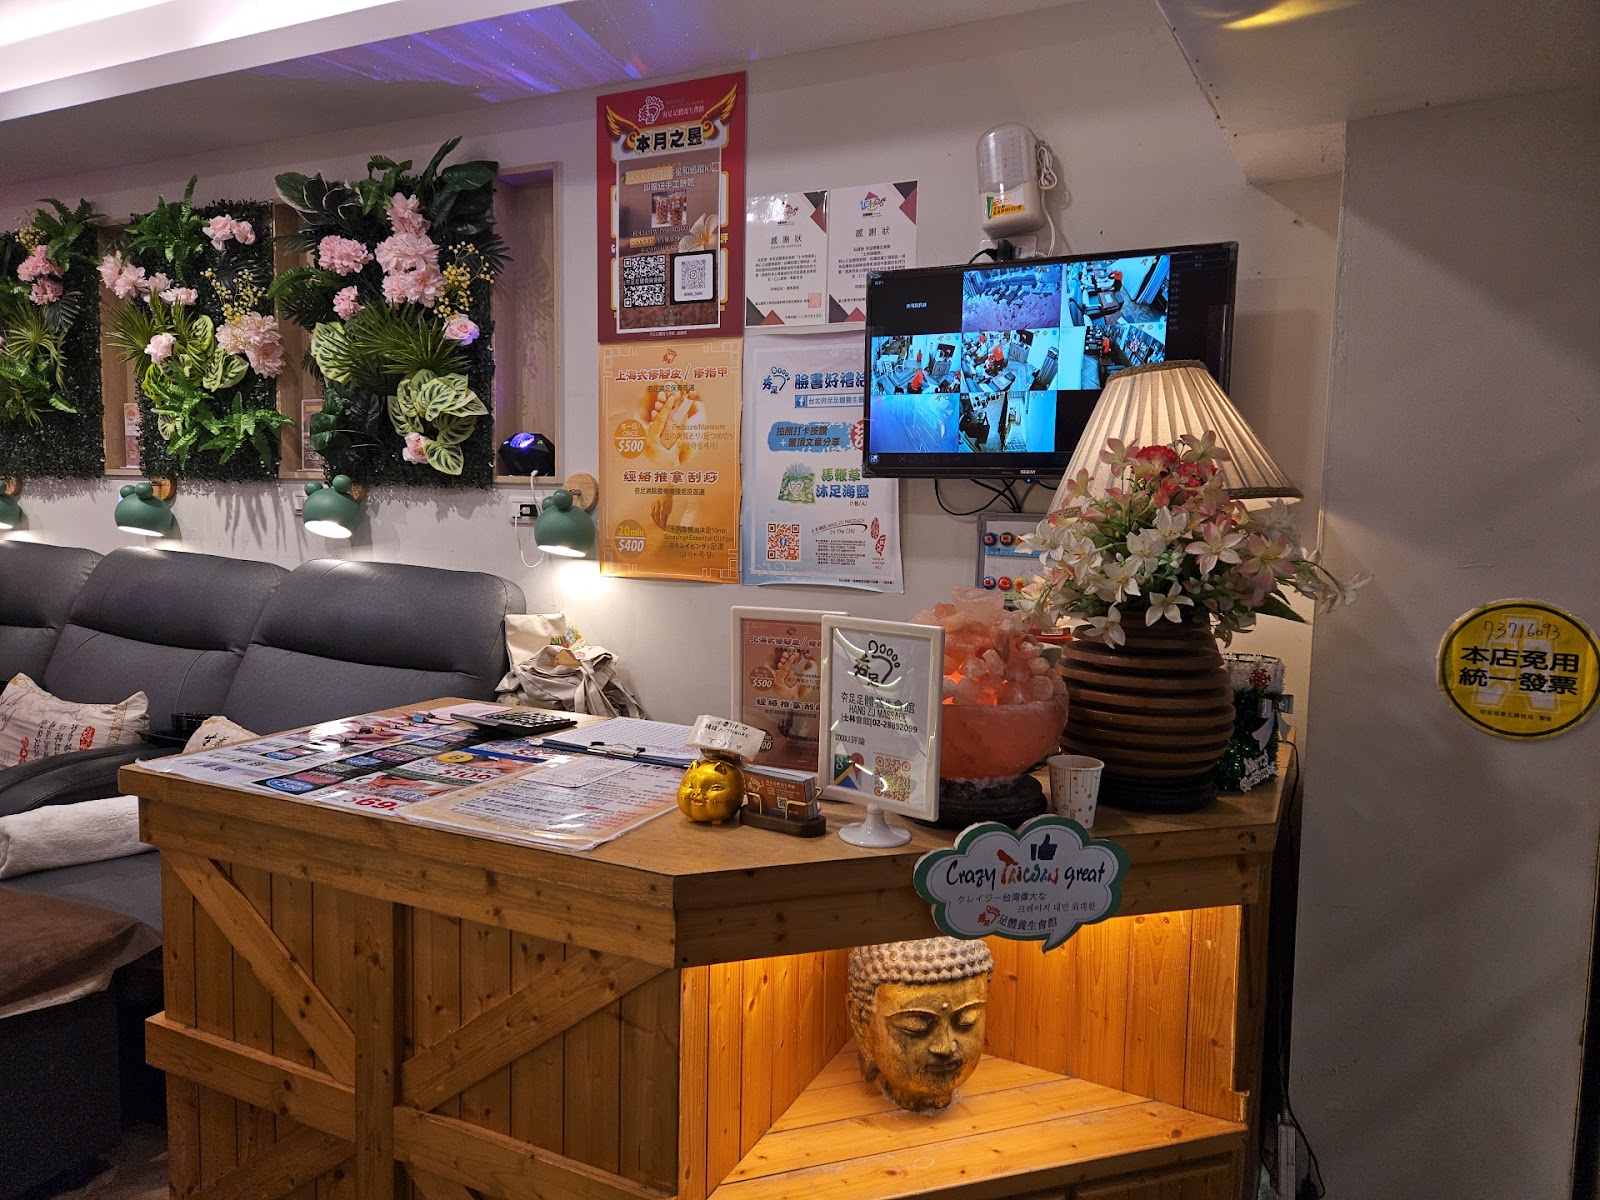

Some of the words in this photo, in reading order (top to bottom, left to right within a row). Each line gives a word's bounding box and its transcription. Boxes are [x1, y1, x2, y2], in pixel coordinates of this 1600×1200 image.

[636, 127, 702, 152] 本月之星
[856, 226, 890, 237] 感謝狀
[770, 234, 802, 245] 感謝狀
[617, 440, 644, 453] $500
[816, 484, 870, 498] 沐足海鹽
[618, 539, 645, 552] $400
[1460, 645, 1579, 673] 本店免用
[752, 678, 772, 688] $500
[1459, 667, 1578, 696] 統一發票
[849, 705, 866, 716] HANG
[868, 708, 876, 717] ZU
[946, 859, 996, 891] Crazy
[1064, 861, 1105, 889] great
